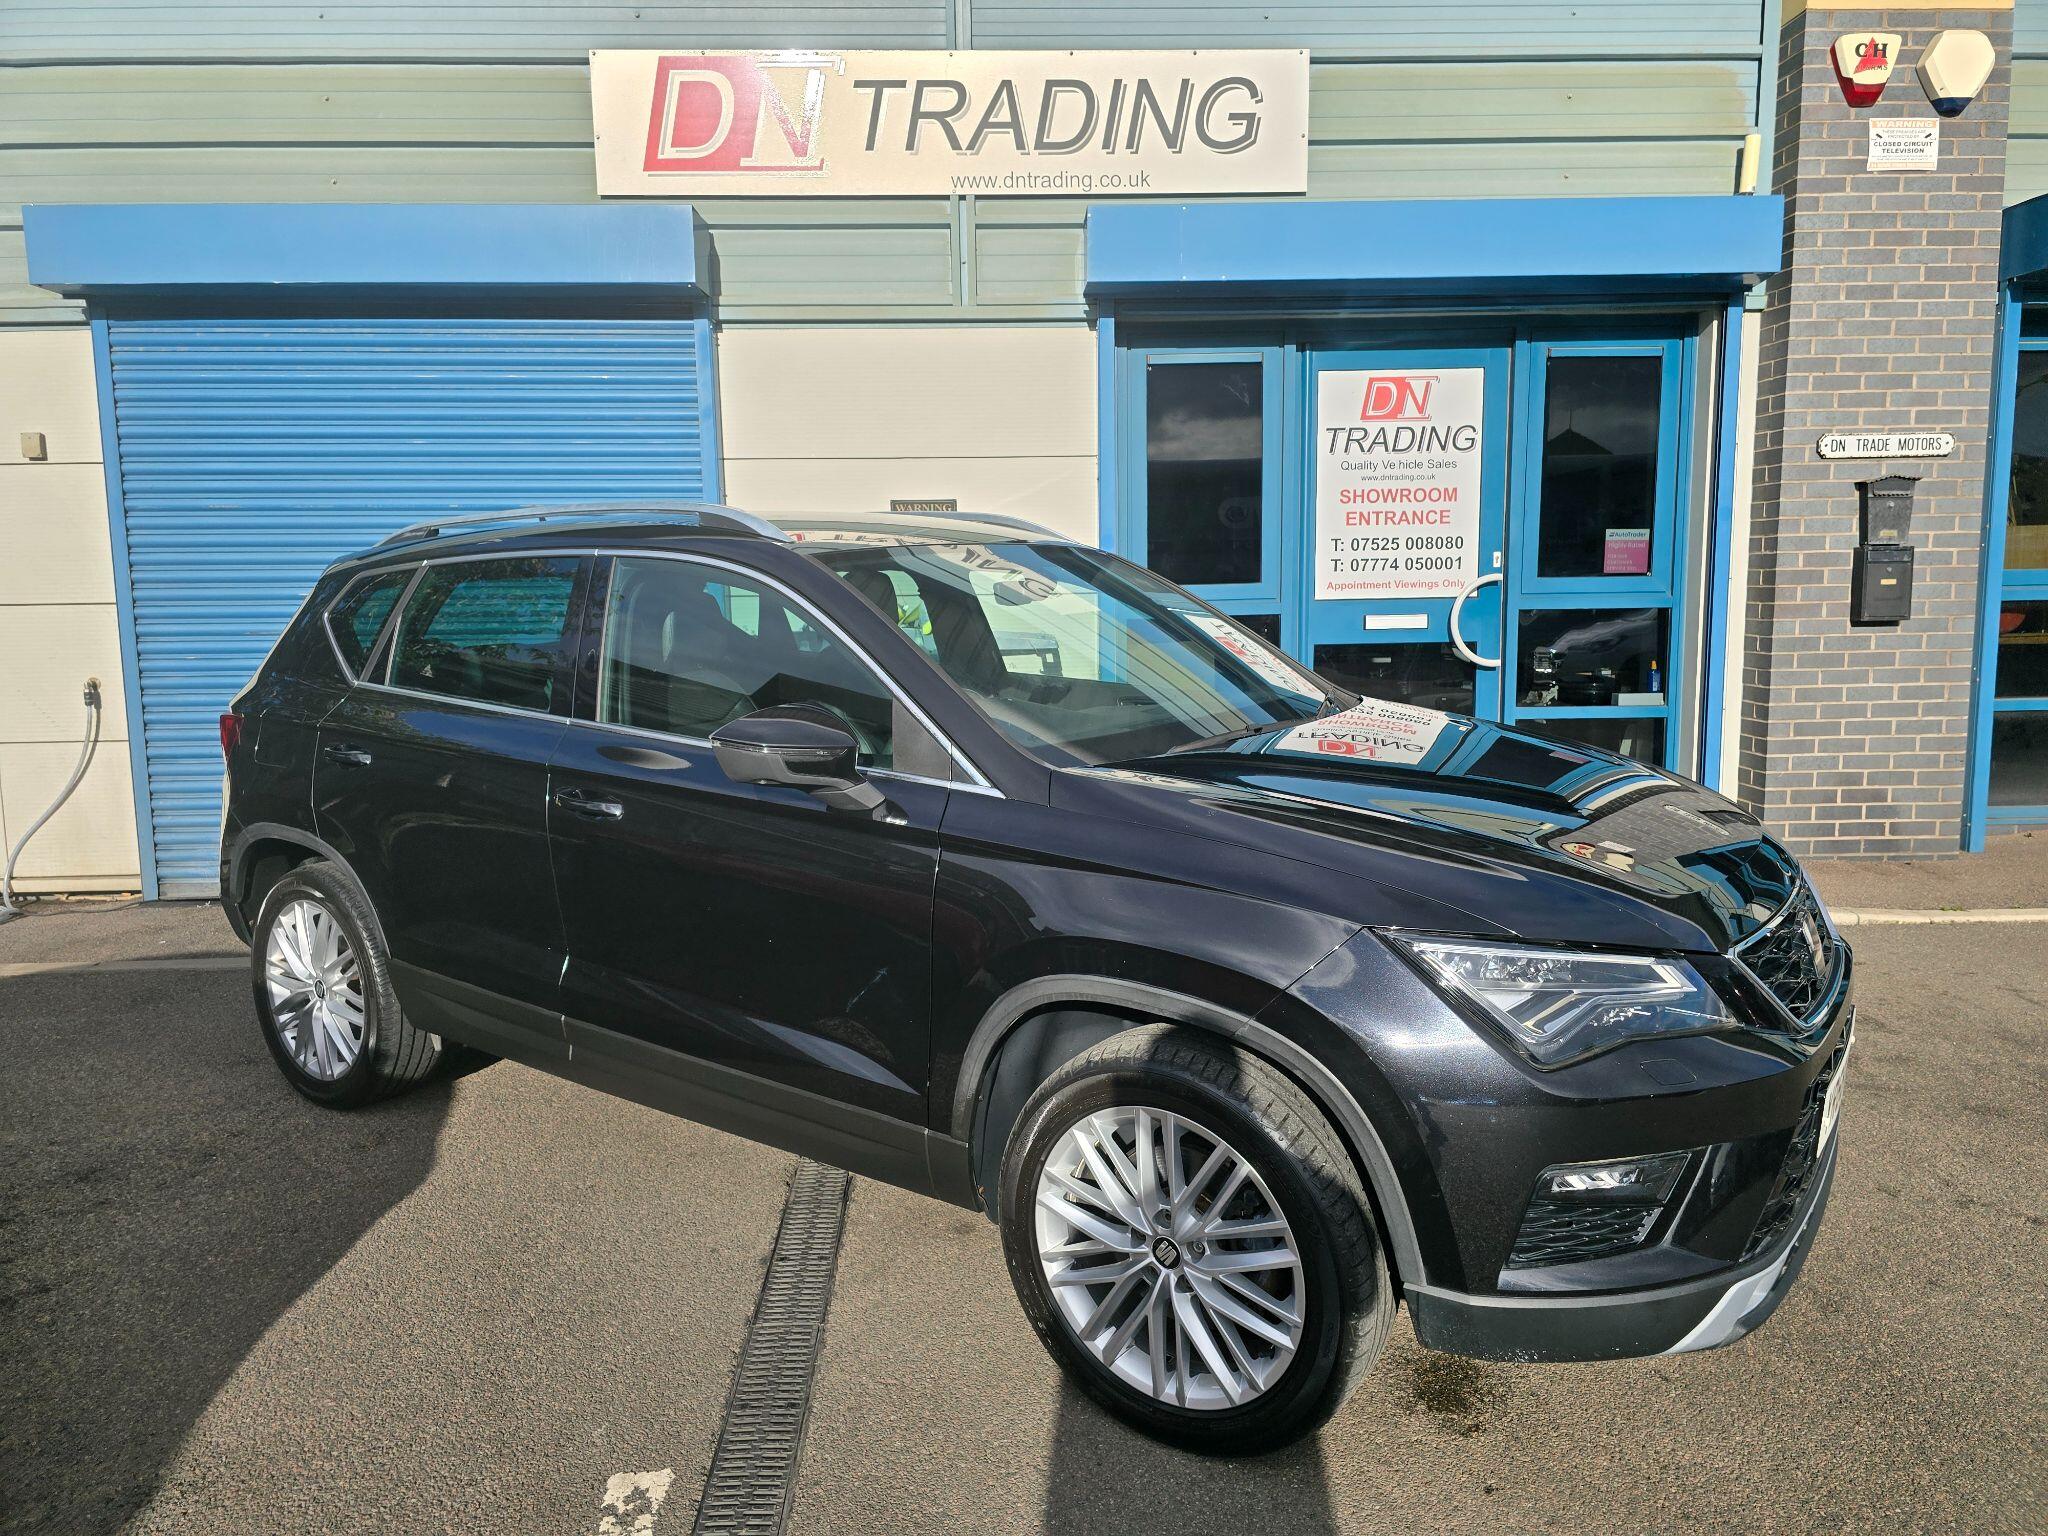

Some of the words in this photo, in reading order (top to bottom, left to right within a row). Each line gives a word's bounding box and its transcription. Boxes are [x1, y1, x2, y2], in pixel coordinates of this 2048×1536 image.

[645, 55, 845, 177] DN
[852, 75, 1263, 156] TRADING
[1876, 120, 1933, 128] WARNING
[950, 170, 1152, 193] www.dntrading.co.uk
[1360, 376, 1440, 422] DN
[1325, 425, 1478, 455] TRADING
[1830, 439, 1846, 453] DN
[1856, 438, 1891, 452] TRADE
[1897, 437, 1942, 451] MOTORS
[1340, 460, 1379, 473] Quality
[1427, 459, 1458, 469] Sales
[1361, 473, 1436, 482] www.dntrading.co.uk
[1339, 487, 1459, 504] SHOWROOM
[895, 503, 952, 512] WARNING
[1345, 509, 1451, 526] ENTRANCE
[1331, 538, 1345, 552] T:
[1350, 537, 1400, 552] 07525
[1405, 536, 1464, 550] 008080
[1331, 558, 1345, 572] T:
[1350, 558, 1400, 572] 07774
[1405, 556, 1463, 570] 050001
[1326, 581, 1391, 592] Appointment
[1394, 580, 1439, 591] Viewings
[1442, 579, 1466, 590] Only
